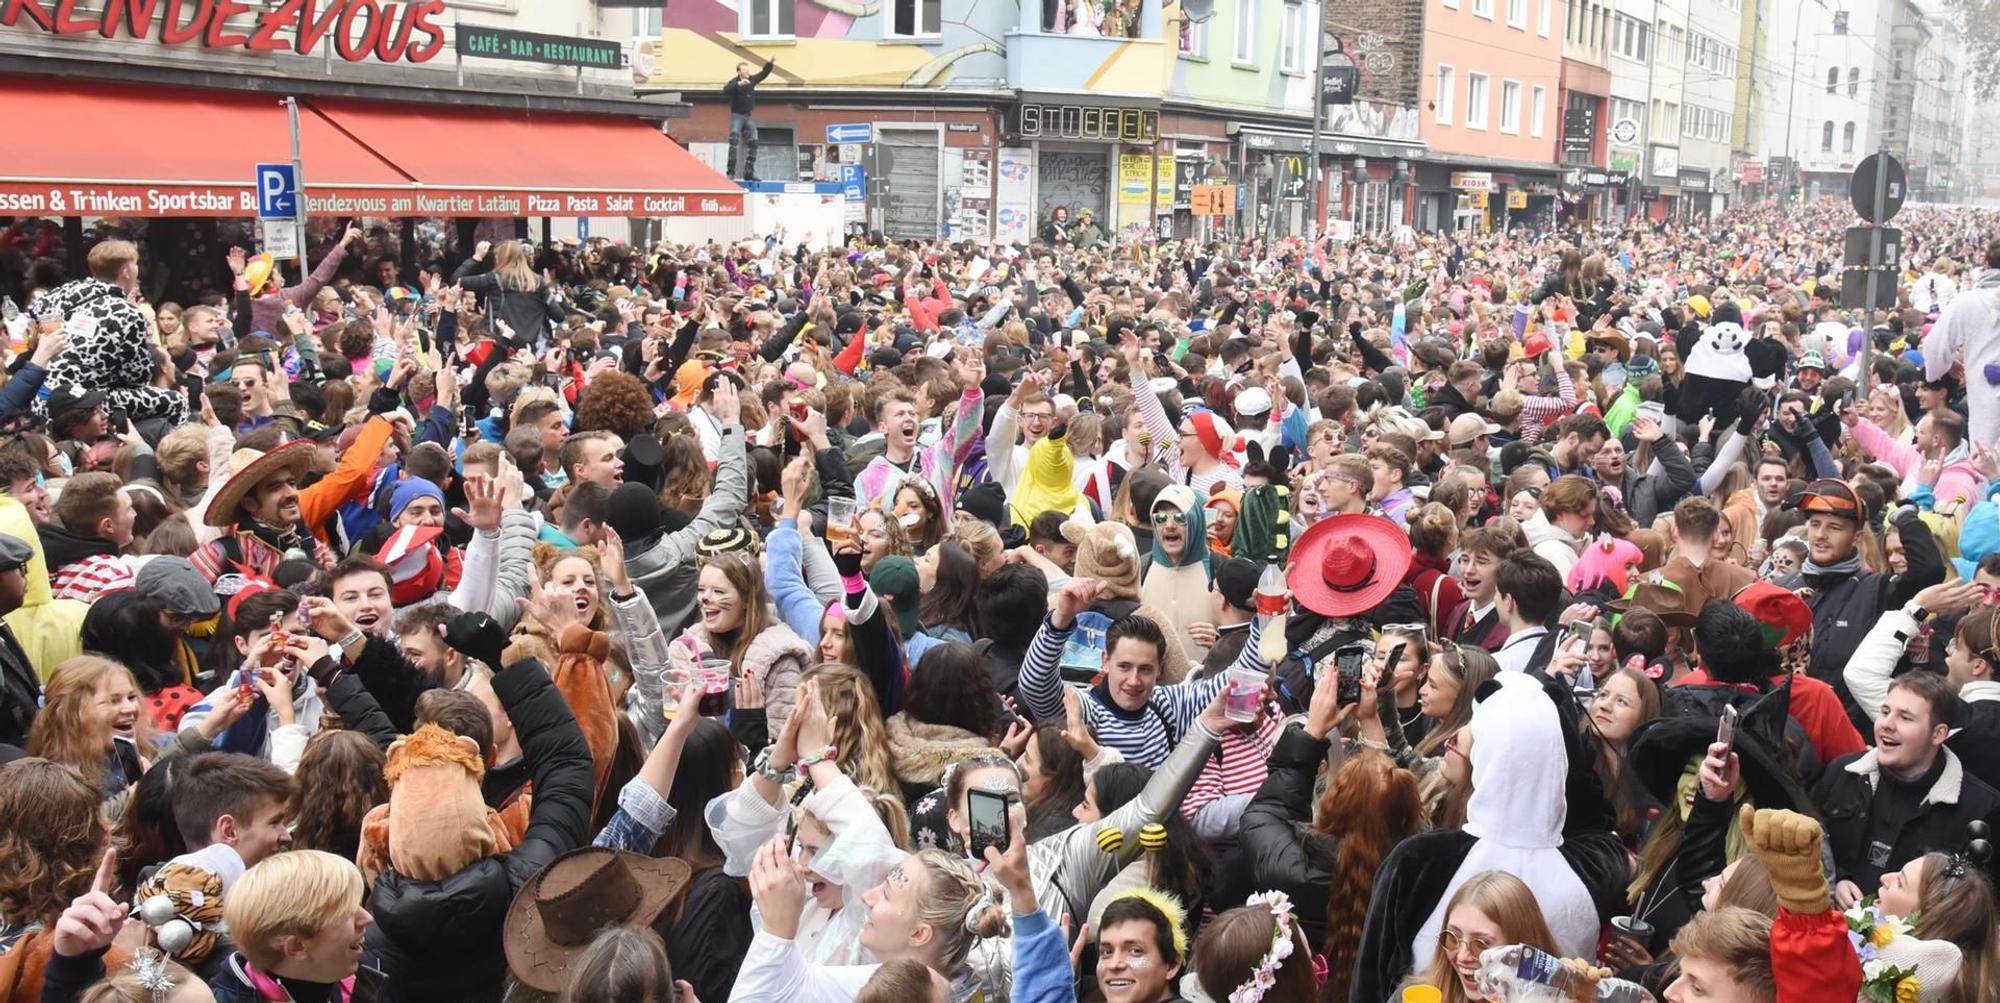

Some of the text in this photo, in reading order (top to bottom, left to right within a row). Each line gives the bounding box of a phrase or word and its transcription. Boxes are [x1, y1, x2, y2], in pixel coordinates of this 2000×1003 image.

[468, 34, 615, 65] CAFÉ BAR RESTAURANT
[1023, 106, 1153, 138] STIEFEL
[263, 171, 286, 211] P
[1462, 179, 1487, 187] KIOSK
[50, 190, 66, 210] &
[70, 190, 142, 211] Trinken
[147, 189, 235, 214] Sportsbar
[391, 198, 412, 212] am
[416, 195, 474, 212] Kwartier
[478, 194, 521, 215] Latäng
[528, 195, 560, 212] Pizza
[567, 195, 599, 212] Pasta
[606, 195, 634, 212] Salat
[643, 195, 685, 212] Cocktail
